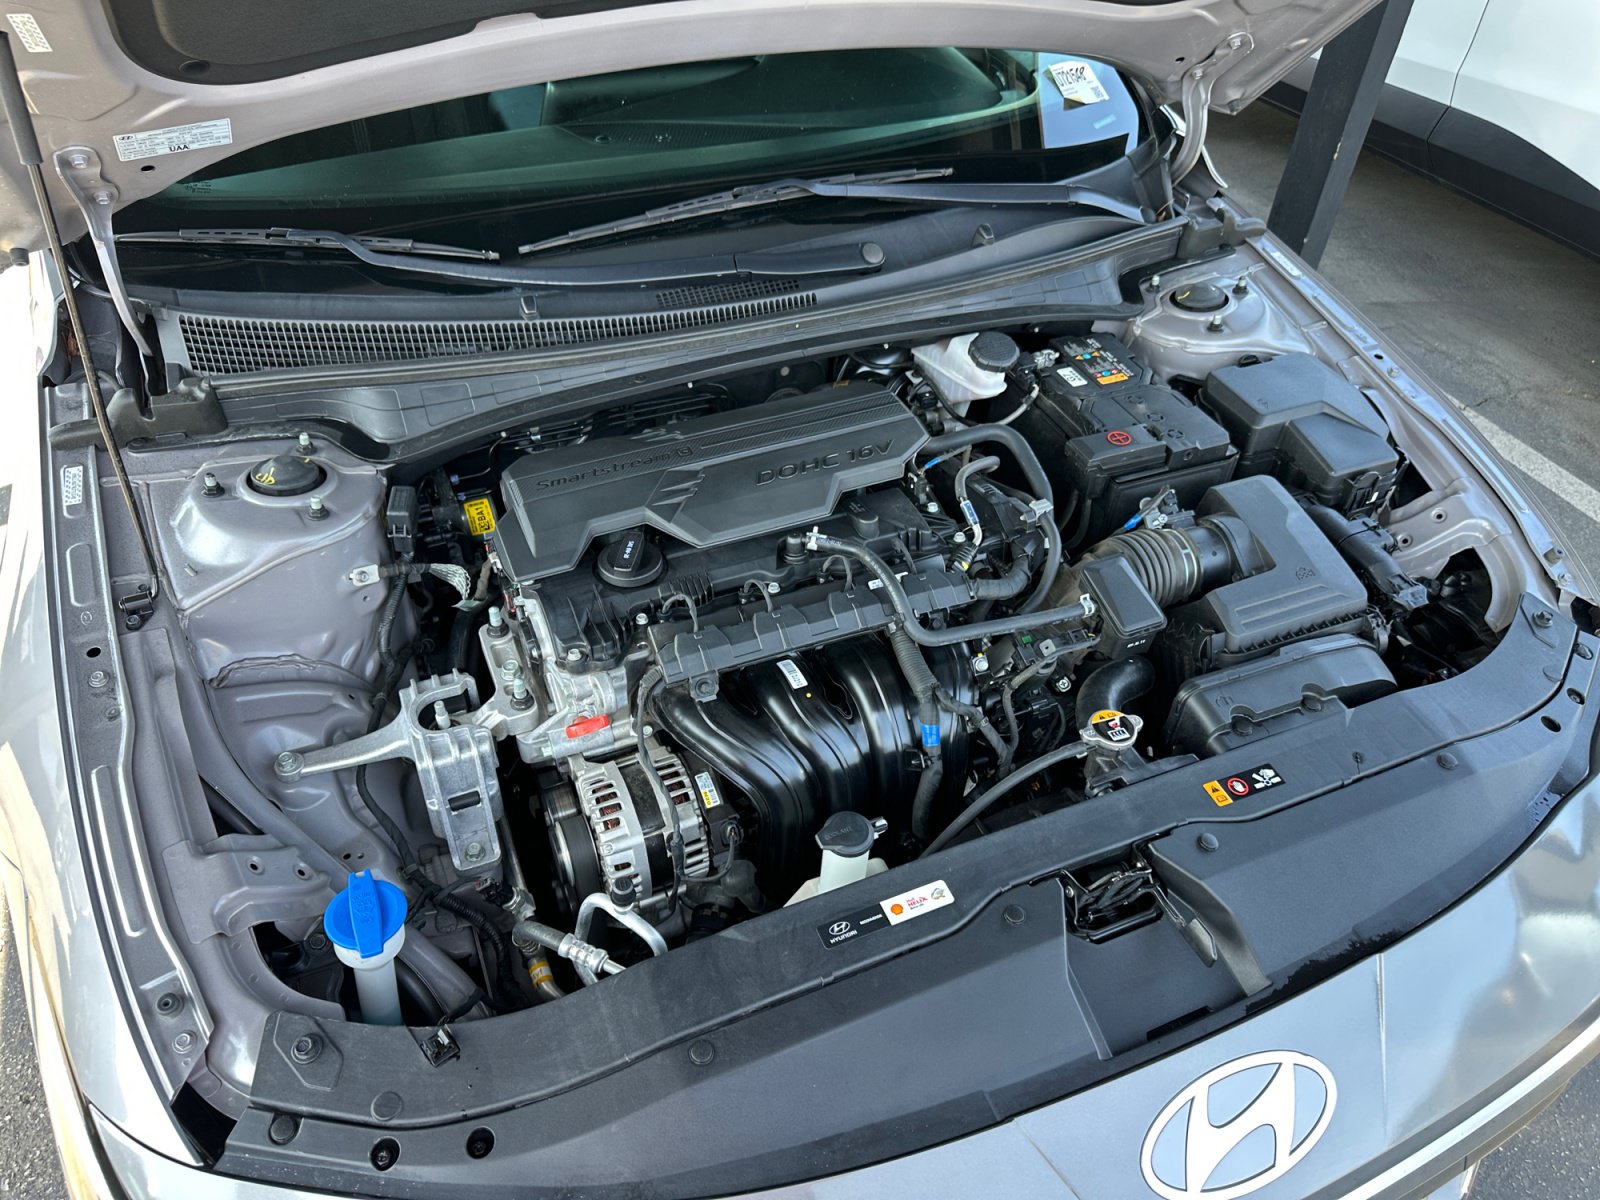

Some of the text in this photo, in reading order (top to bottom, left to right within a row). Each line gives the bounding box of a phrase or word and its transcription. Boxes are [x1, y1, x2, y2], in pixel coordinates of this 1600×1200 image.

[169, 144, 190, 153] UAA
[535, 452, 672, 492] Smartstream
[756, 438, 896, 486] DOHC 16V
[830, 930, 858, 944] HYUNDAI
